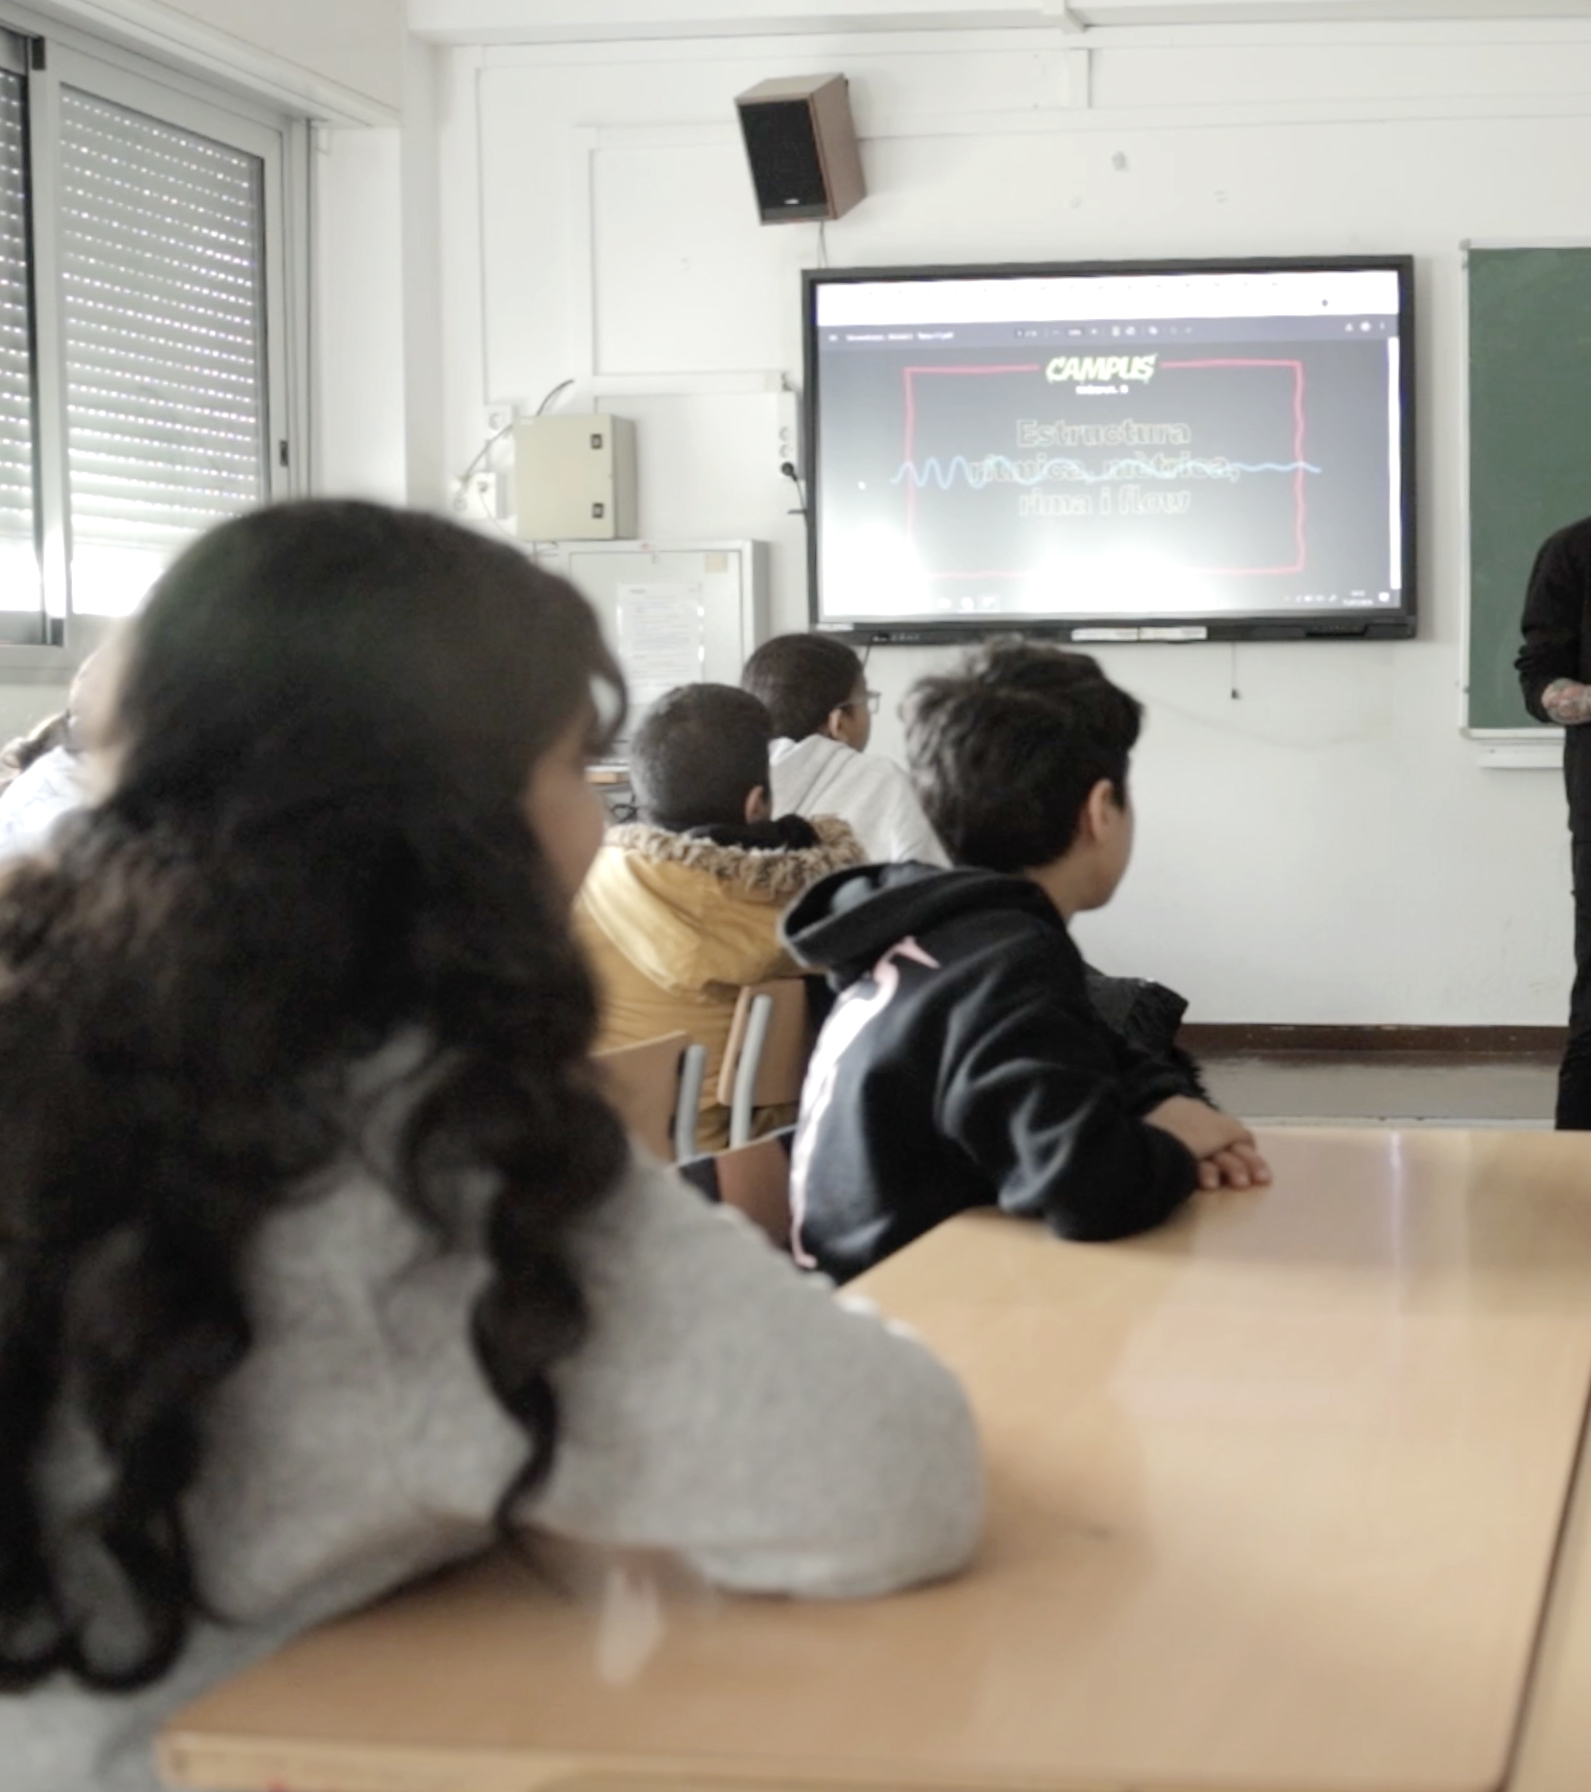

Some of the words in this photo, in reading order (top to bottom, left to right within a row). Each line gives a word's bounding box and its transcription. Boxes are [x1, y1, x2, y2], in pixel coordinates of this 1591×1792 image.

[1045, 353, 1158, 384] CAMPUS
[1016, 418, 1192, 448] Estructura
[1018, 486, 1092, 516] rima
[1100, 485, 1111, 515] i
[1118, 484, 1191, 516] flow
